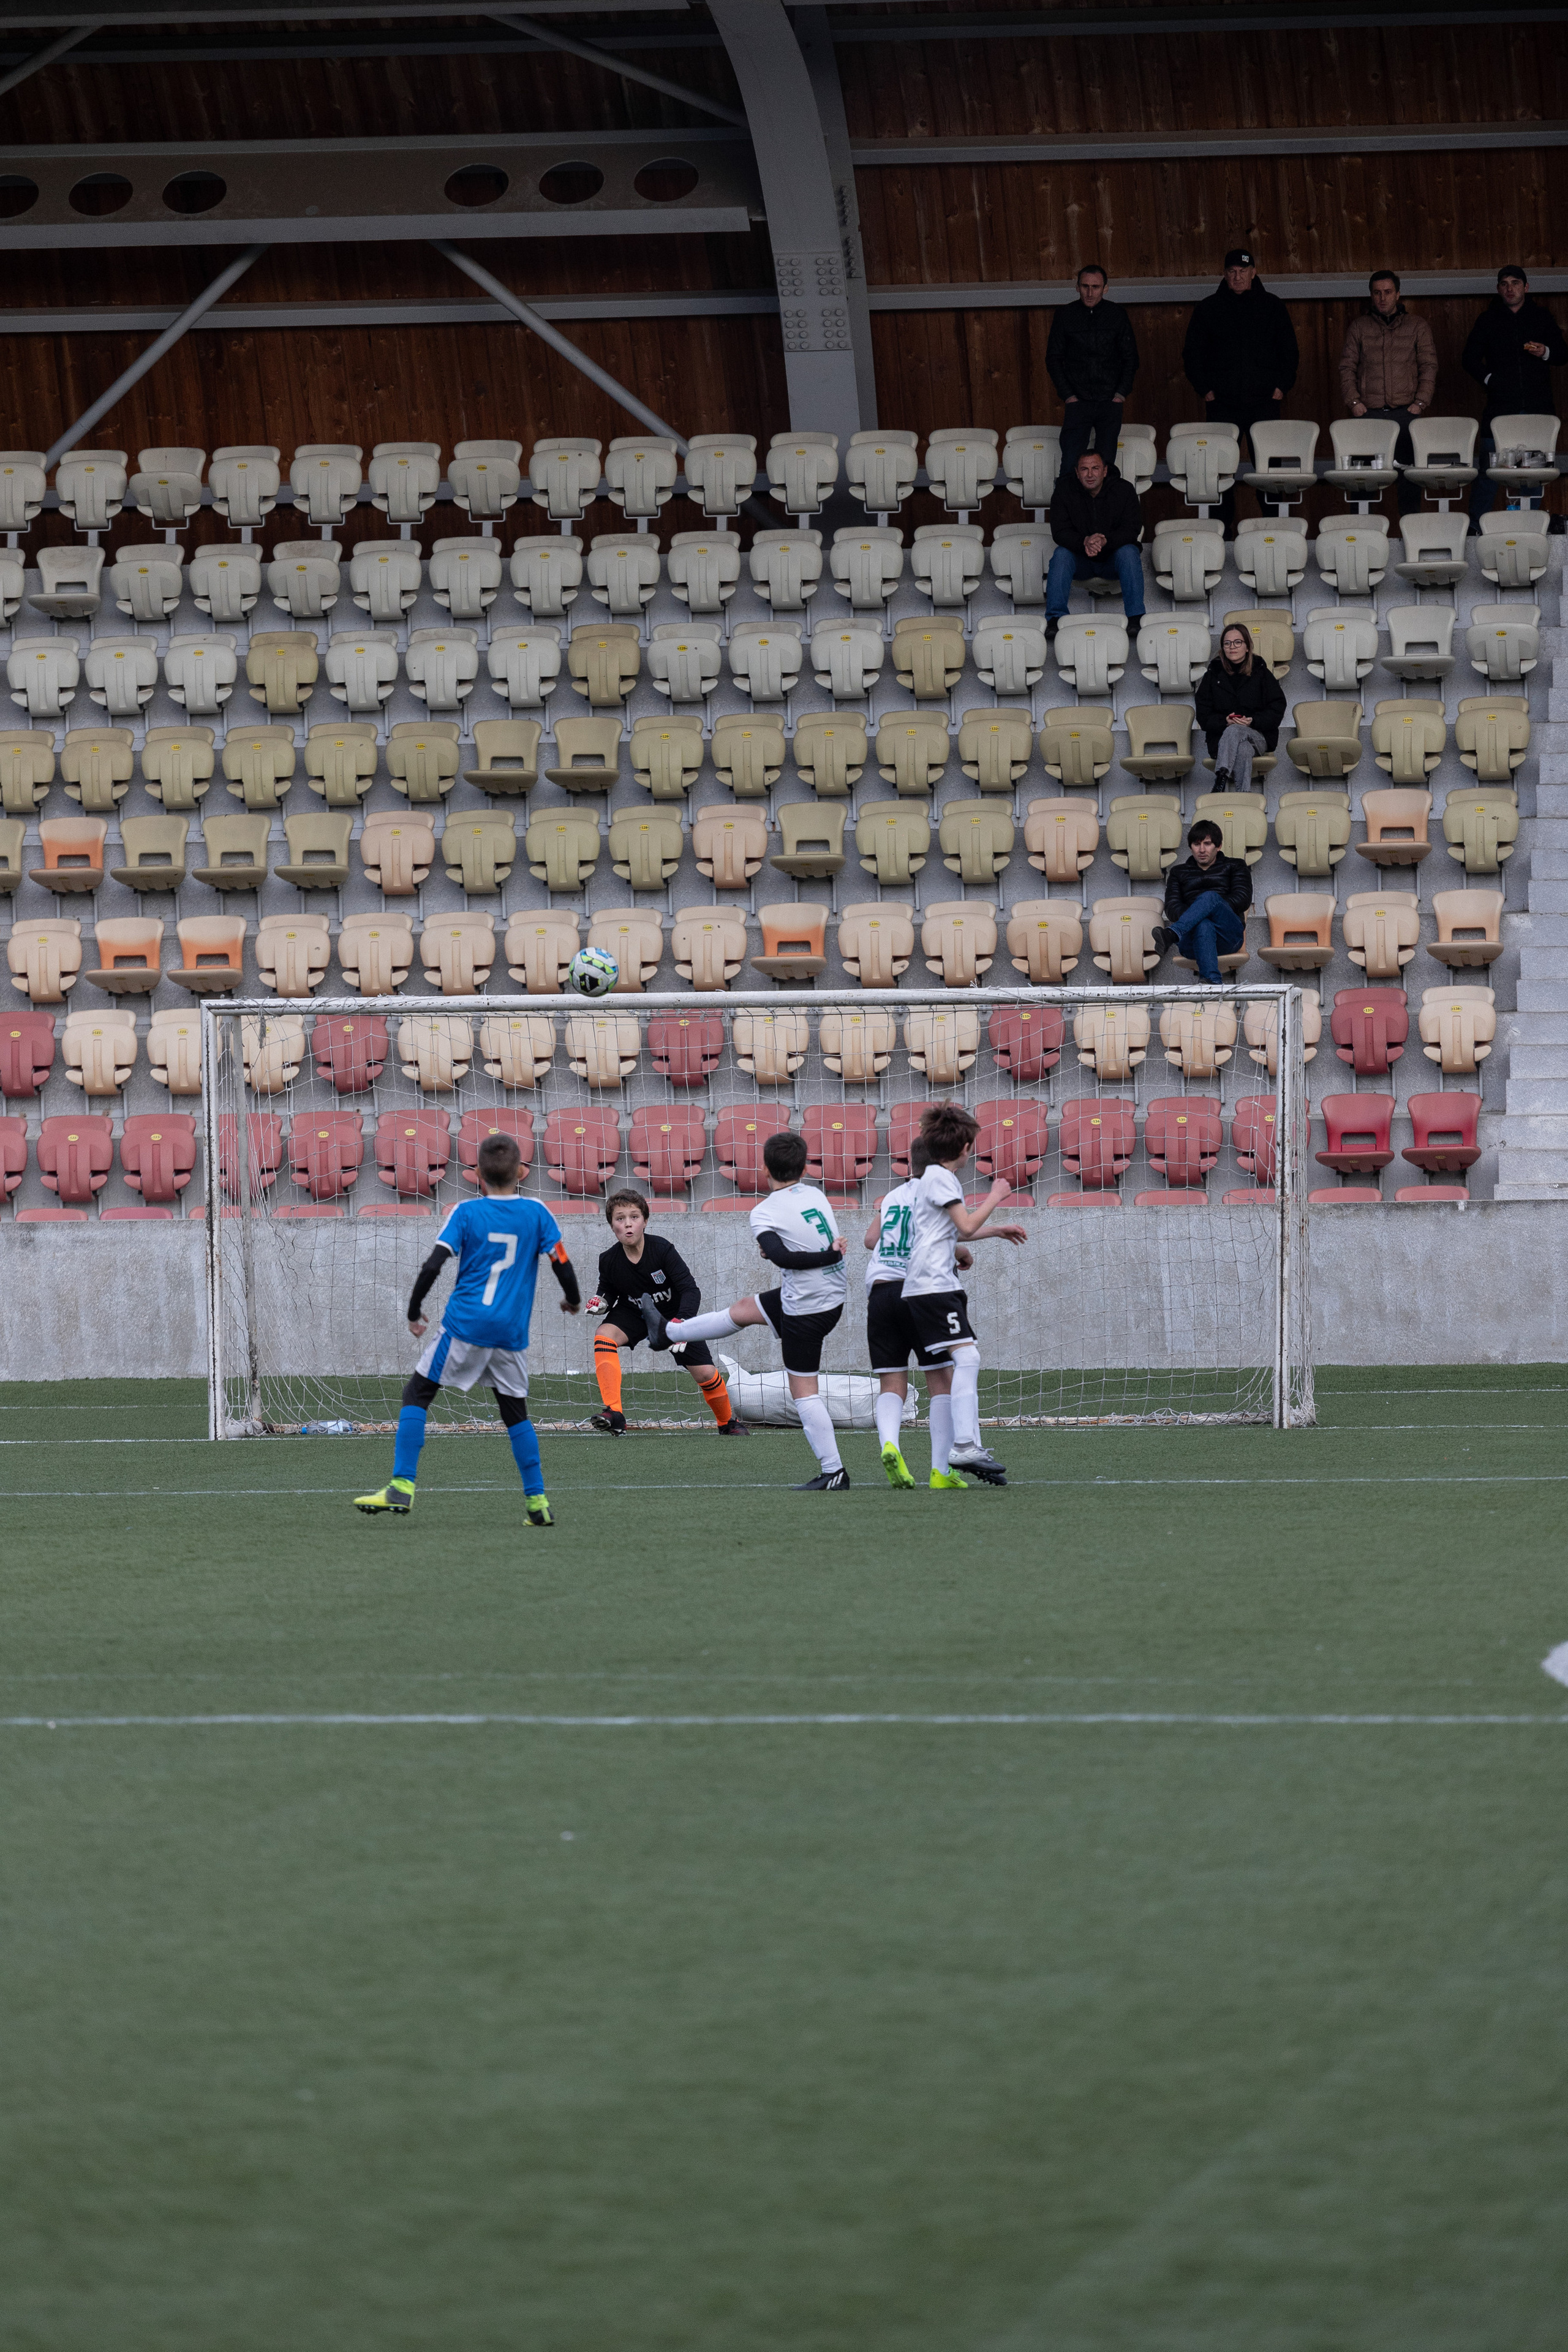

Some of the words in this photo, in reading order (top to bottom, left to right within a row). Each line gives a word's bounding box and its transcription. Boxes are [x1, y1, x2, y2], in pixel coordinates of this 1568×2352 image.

[801, 1208, 834, 1252] 3
[878, 1205, 912, 1257] 21
[481, 1232, 518, 1306] 7
[946, 1311, 962, 1335] 5
